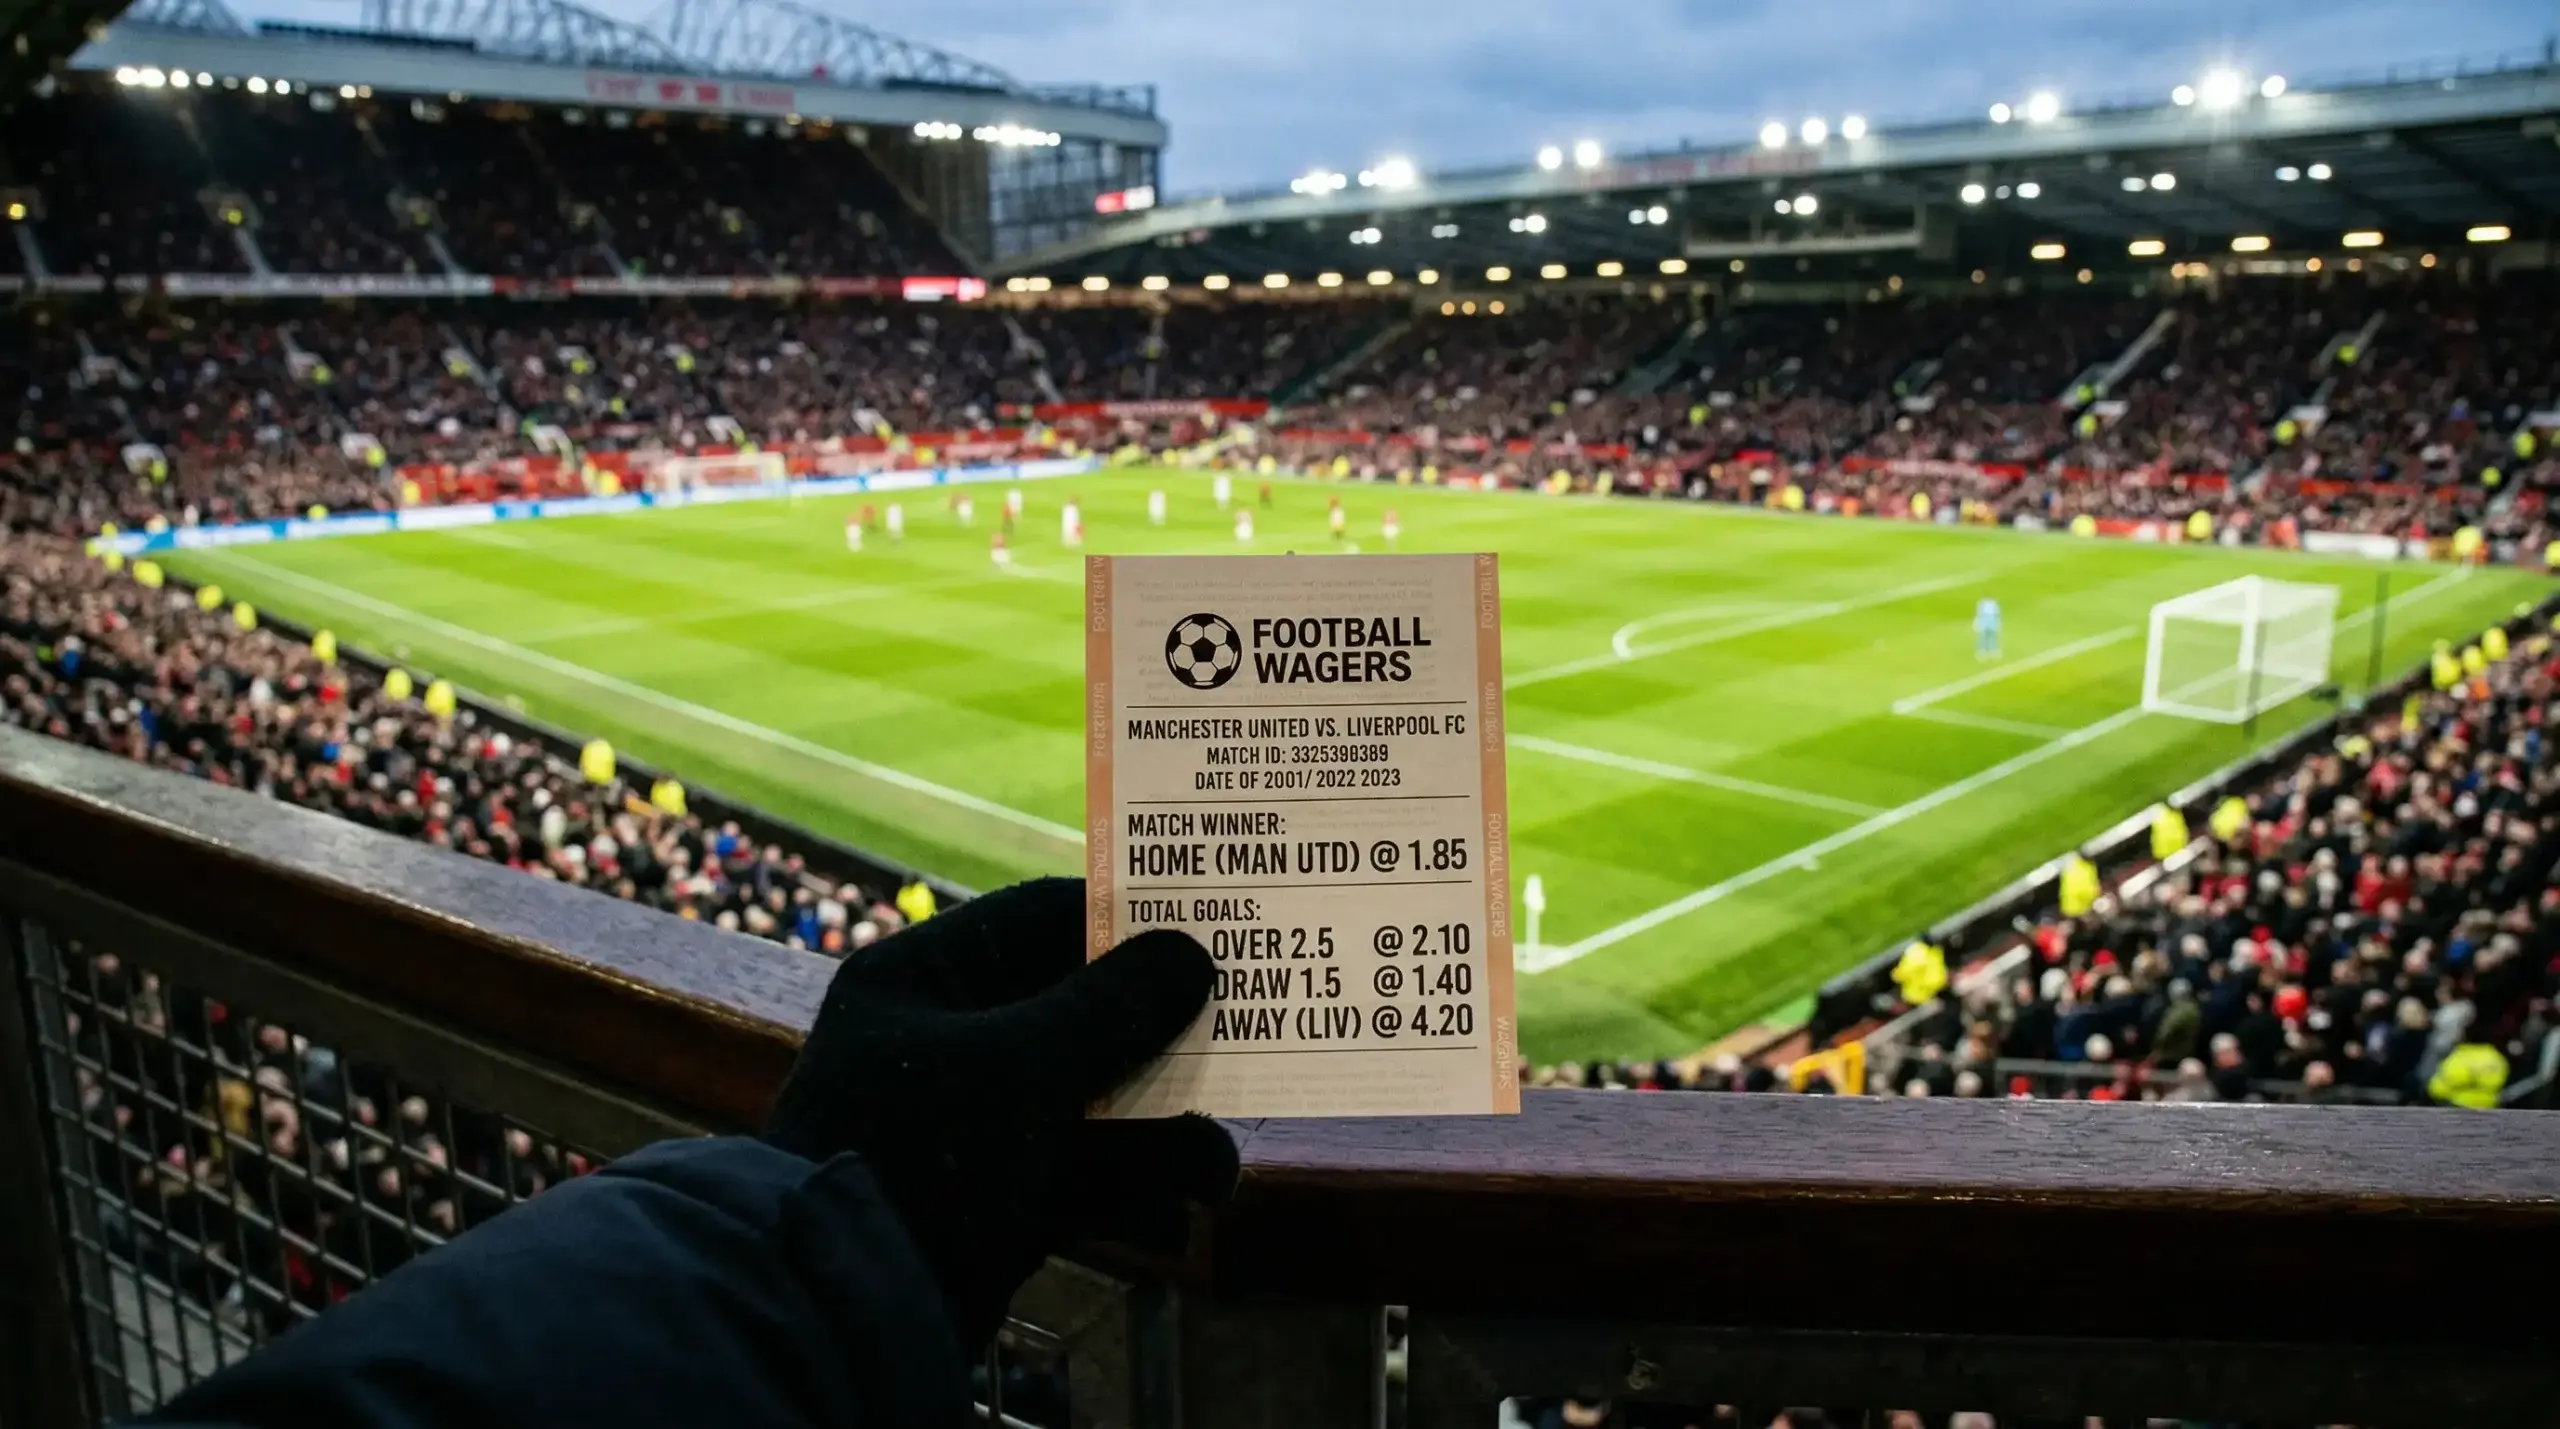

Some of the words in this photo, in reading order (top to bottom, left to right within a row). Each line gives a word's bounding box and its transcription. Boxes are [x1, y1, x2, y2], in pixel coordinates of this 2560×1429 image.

[1254, 617, 1431, 648] FOOTBALL
[1254, 651, 1411, 683] WAGERS
[1129, 719, 1242, 739] MANCHESTER
[1249, 718, 1309, 738] UNITED
[1315, 718, 1340, 737] VS.
[1348, 716, 1439, 736] LIVERPOOL
[1446, 715, 1464, 734] FC
[1208, 747, 1259, 764] MATCH
[1266, 747, 1285, 763] ID:
[1196, 772, 1233, 789] DATE
[1240, 771, 1259, 789] OF
[1264, 769, 1312, 788] 2001/
[1317, 769, 1355, 787] 2022
[1361, 769, 1400, 786] 2023
[1129, 814, 1193, 836] MATCH
[1201, 813, 1285, 835] WINNER:
[1130, 844, 1205, 876] HOME
[1216, 843, 1286, 875] (MAN
[1298, 841, 1359, 873] UTD)
[1370, 841, 1399, 872] @
[1408, 839, 1466, 870] 1.85
[1128, 900, 1187, 922] TOTAL
[1194, 899, 1260, 922] GOALS:
[1211, 928, 1283, 961] OVER
[1291, 927, 1333, 959] 2.5
[1374, 926, 1403, 957] @
[1413, 924, 1469, 955] 2.10
[1213, 967, 1292, 1001] DRAW
[1301, 967, 1340, 998] 1.5
[1374, 965, 1403, 997] @
[1413, 963, 1471, 995] 1.40
[1212, 1007, 1288, 1041] AWAY
[1297, 1006, 1361, 1040] (LIV)
[1372, 1005, 1402, 1038] @
[1411, 1004, 1473, 1036] 4.20
